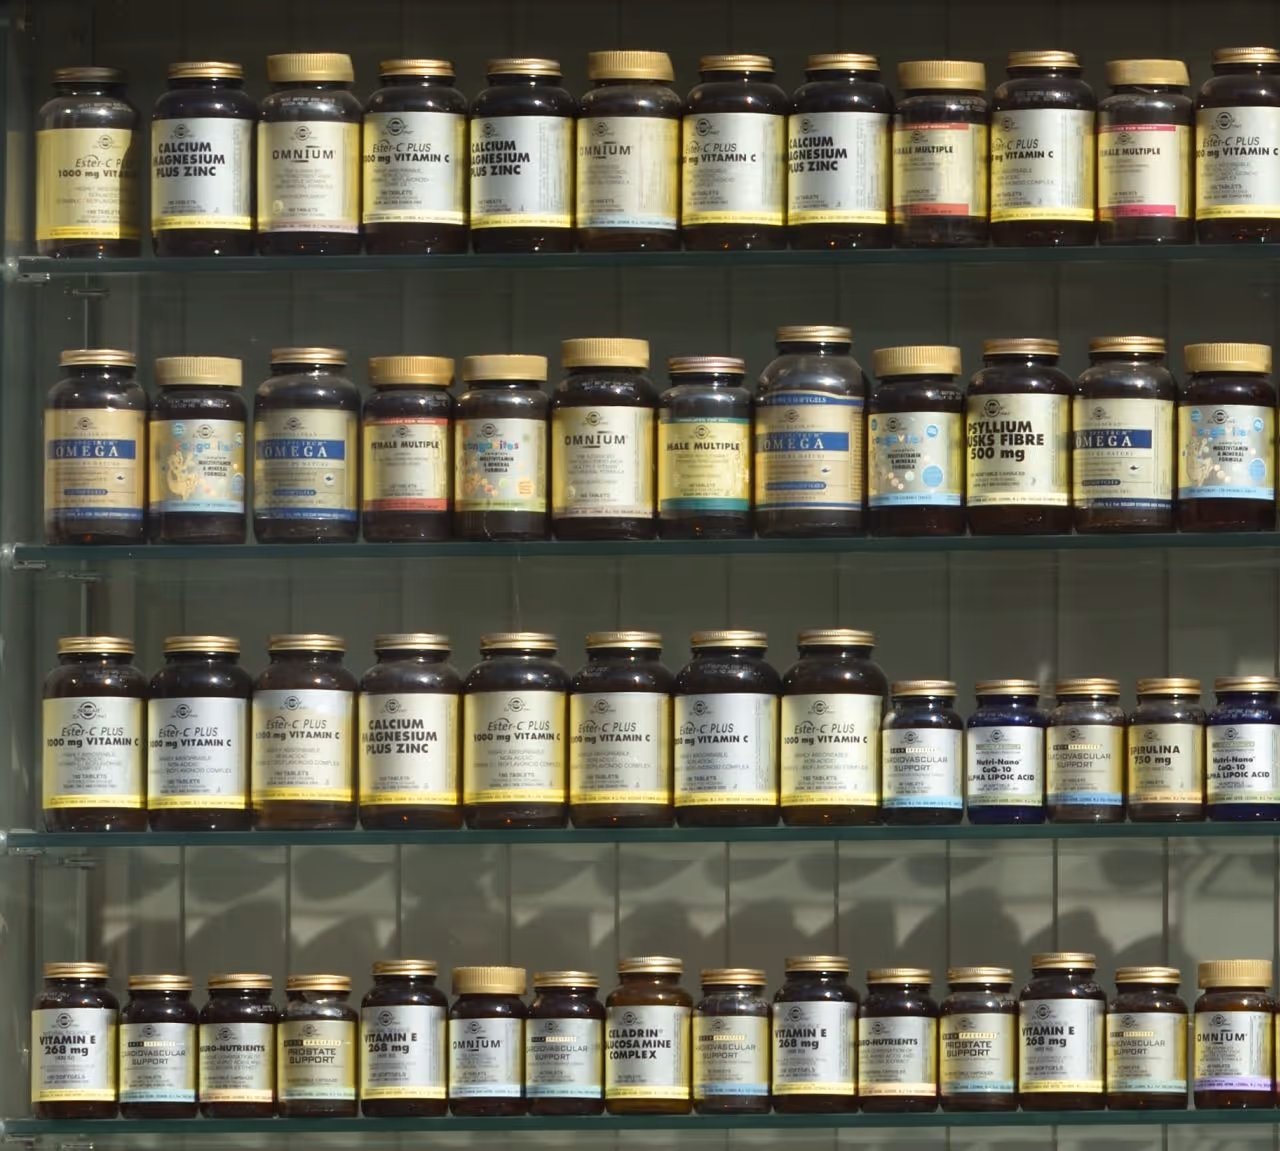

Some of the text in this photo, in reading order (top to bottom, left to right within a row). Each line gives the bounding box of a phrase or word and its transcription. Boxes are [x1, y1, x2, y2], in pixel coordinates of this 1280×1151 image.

[159, 142, 212, 153] CALCIUM
[407, 143, 432, 152] PLUS
[712, 143, 736, 153] PLUS
[1016, 139, 1038, 150] PLUS
[1005, 150, 1046, 159] VITAMIN
[1223, 147, 1271, 157] VITAMIN
[394, 153, 439, 163] VITAMIN
[701, 154, 748, 163] VITAMIN
[490, 165, 521, 175] ZINC
[808, 161, 838, 172] ZINC
[184, 167, 216, 177] ZINC
[1000, 434, 1045, 446] FIBRE
[55, 443, 119, 458] OMEGA
[400, 441, 440, 450] MULTIPLE
[694, 442, 741, 452] MULTIPLE
[970, 448, 1025, 462] 500 mg
[368, 720, 424, 730] CALCIUM
[514, 732, 553, 741] VITAMIN
[698, 735, 741, 744] VITAMIN
[817, 735, 861, 744] VITAMIN
[87, 737, 132, 747] VITAMIN
[180, 738, 222, 747] VITAMIN
[396, 743, 429, 753] ZINC
[1155, 757, 1172, 767] mg
[39, 1035, 85, 1046] VITAMIN
[801, 1040, 819, 1051] mg
[1050, 1038, 1067, 1049] mg
[45, 1045, 89, 1058] 268 mg
[368, 1043, 410, 1055] 268 mg
